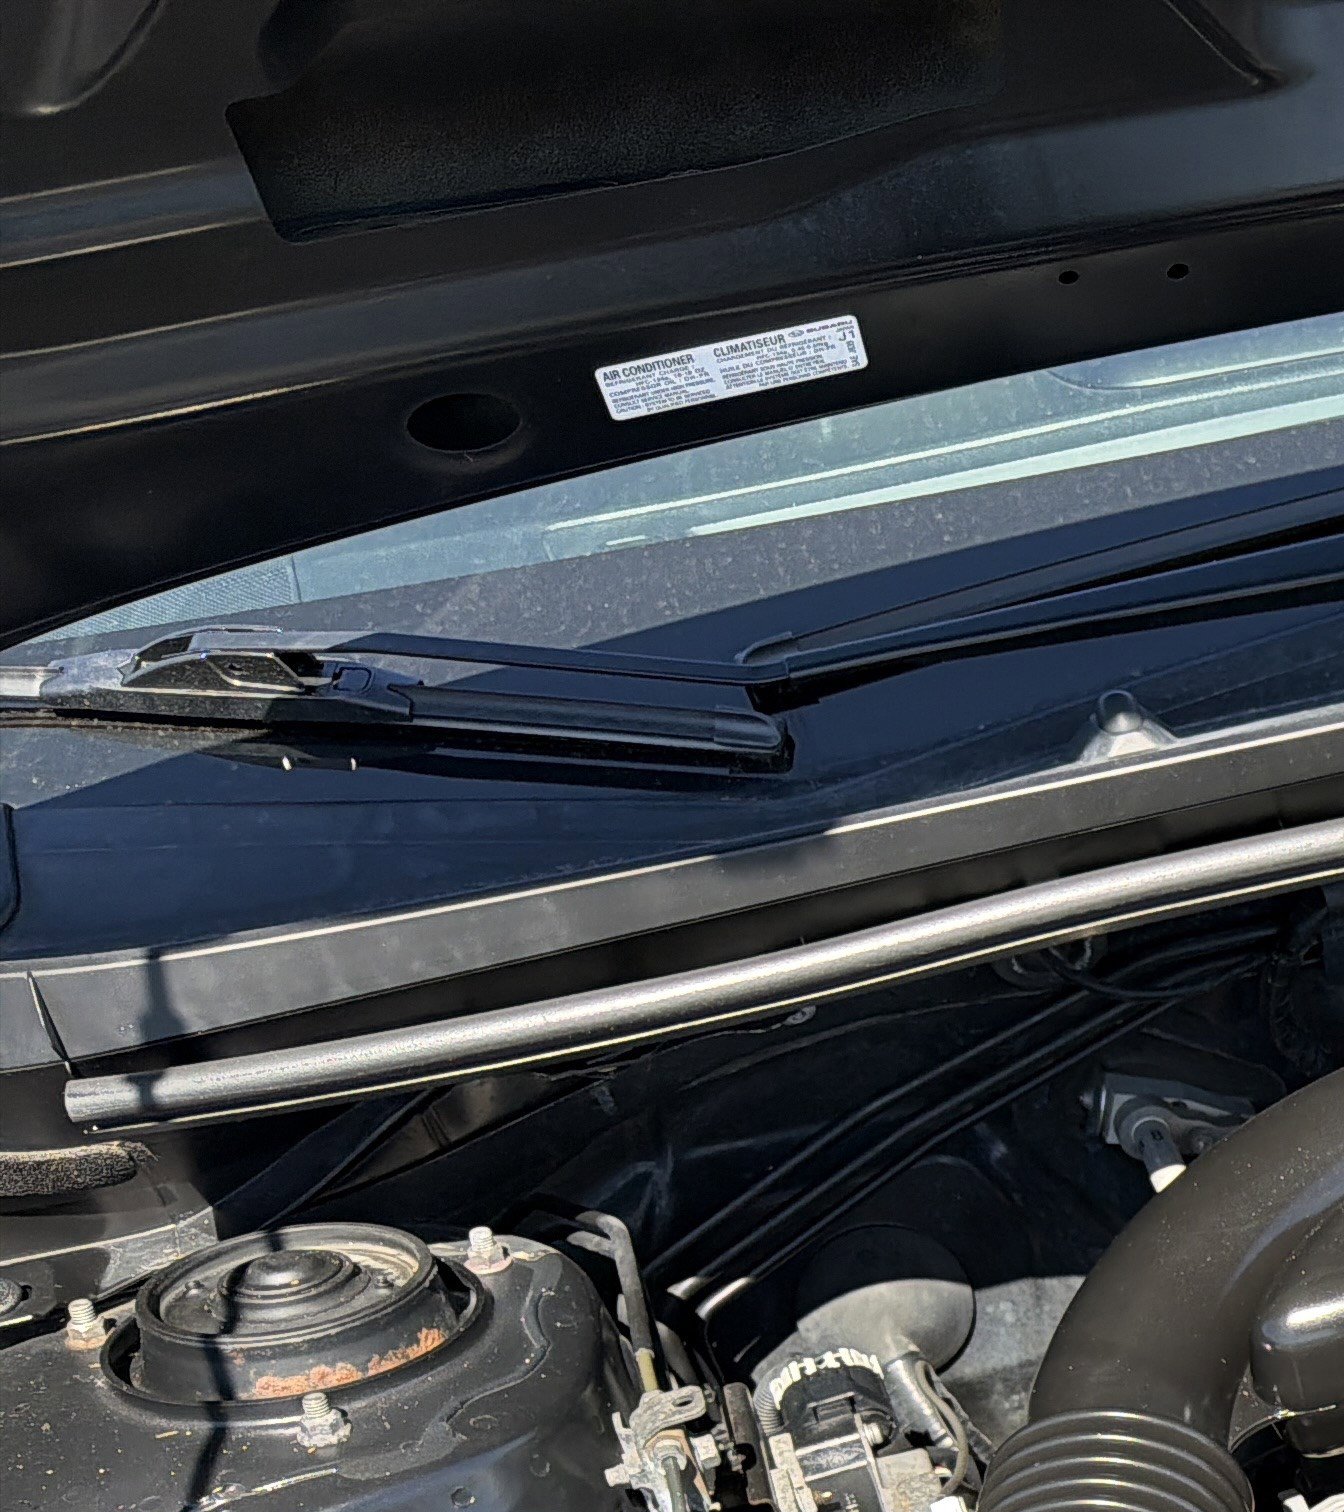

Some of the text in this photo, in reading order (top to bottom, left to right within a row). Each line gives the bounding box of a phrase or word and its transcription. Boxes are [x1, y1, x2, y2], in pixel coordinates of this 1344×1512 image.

[713, 333, 786, 358] CLIMATISEUR
[603, 353, 695, 382] AIR CONDITIONER
